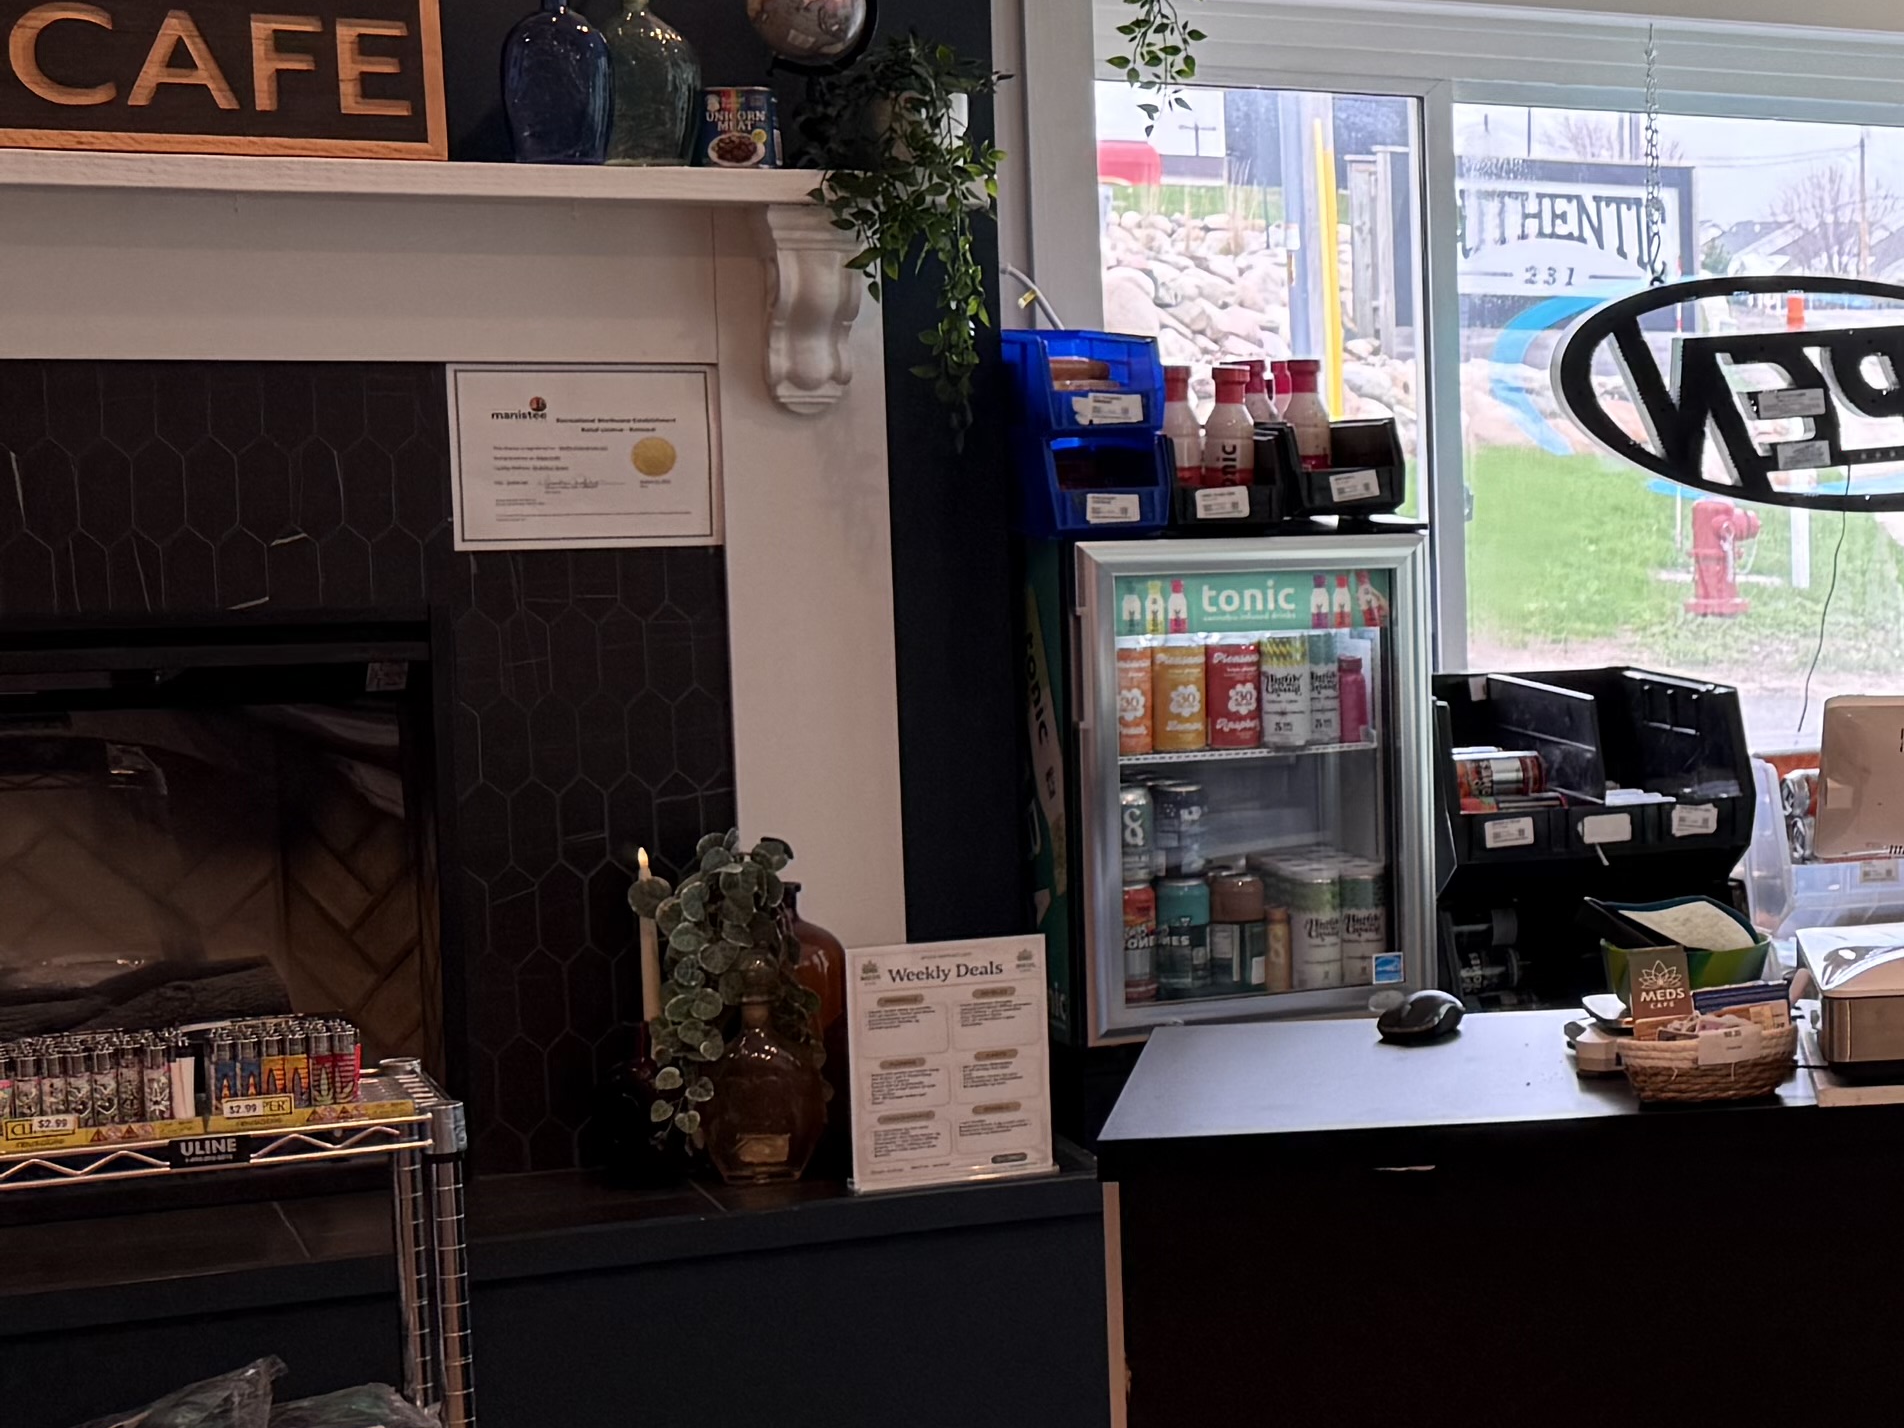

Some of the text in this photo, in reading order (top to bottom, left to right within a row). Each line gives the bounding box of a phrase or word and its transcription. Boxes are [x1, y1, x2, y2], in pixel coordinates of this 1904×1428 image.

[8, 1, 413, 118] CAFE
[705, 110, 766, 122] UNICORN
[717, 120, 752, 132] MEAT
[1524, 265, 1575, 286] 231
[491, 410, 547, 421] manistee
[1202, 579, 1296, 613] tonic
[888, 964, 951, 984] Weekly
[956, 960, 1004, 979] Deals
[1640, 987, 1685, 1002] MEDS
[1650, 1001, 1675, 1010] CAFE
[37, 1118, 68, 1129] $2.99
[180, 1137, 238, 1157] ULINE
